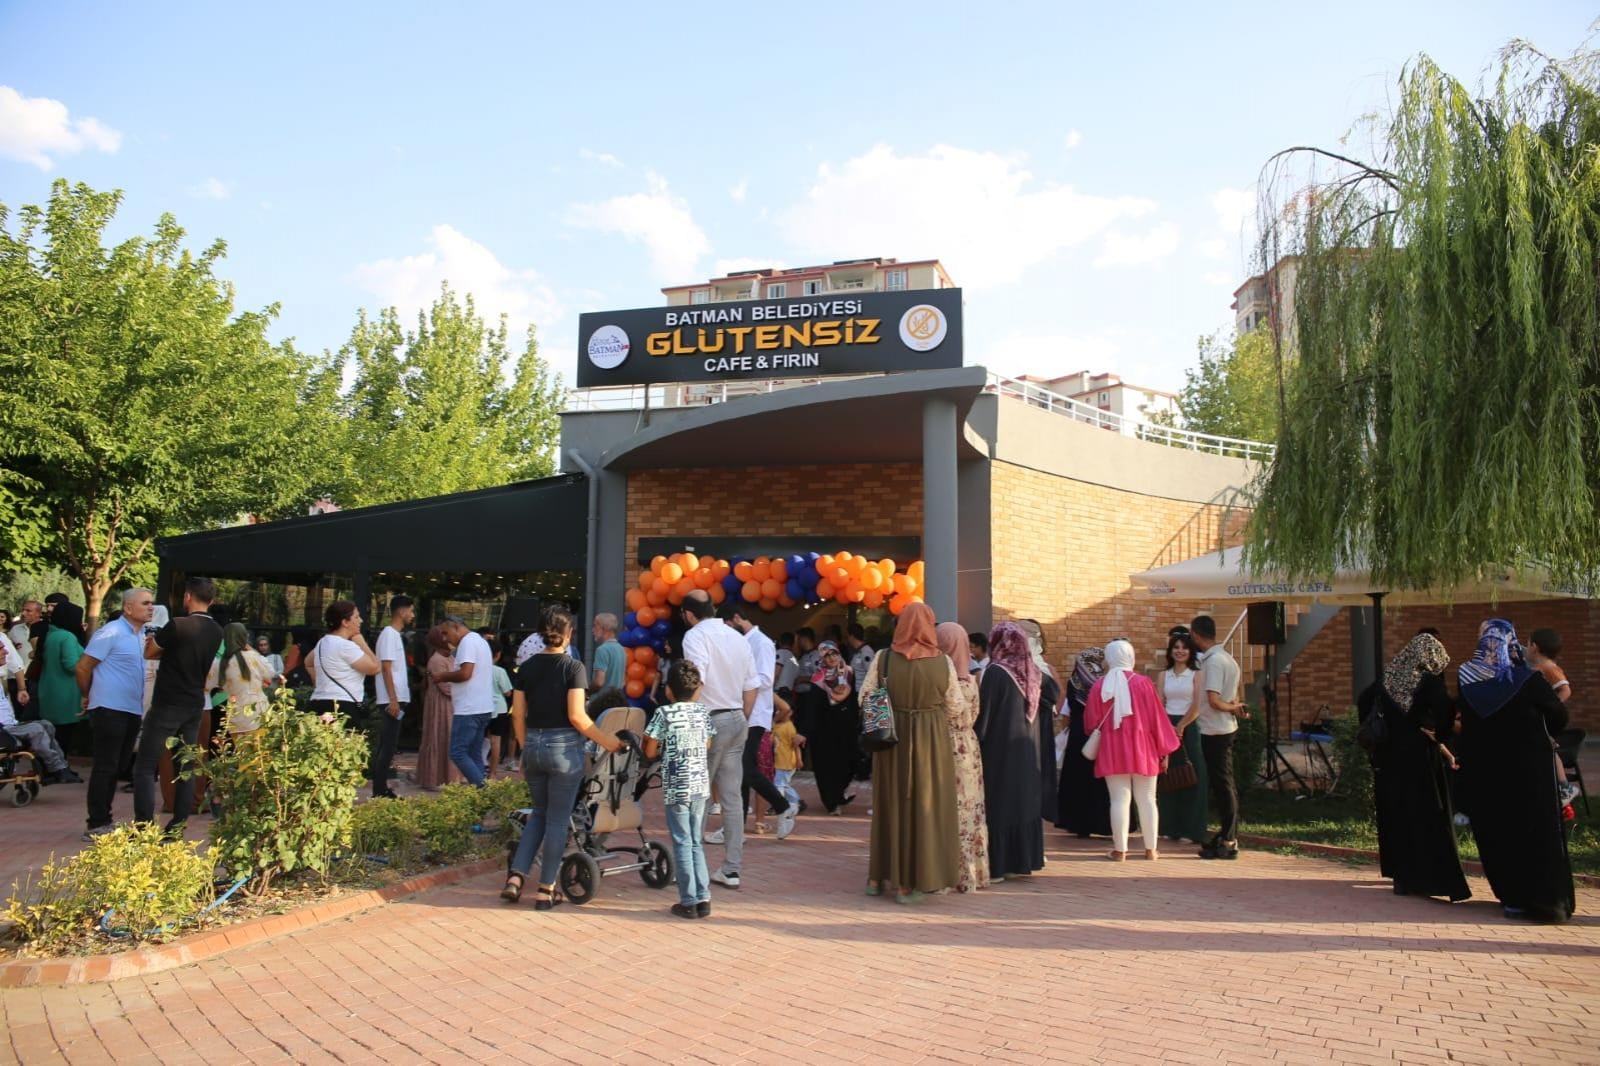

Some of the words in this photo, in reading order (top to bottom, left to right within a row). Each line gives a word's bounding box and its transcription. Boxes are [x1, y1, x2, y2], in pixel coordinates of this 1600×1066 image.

[666, 308, 742, 326] BATMAN
[704, 357, 752, 372] CAFE
[756, 355, 769, 369] &
[773, 353, 819, 369] FIRIN
